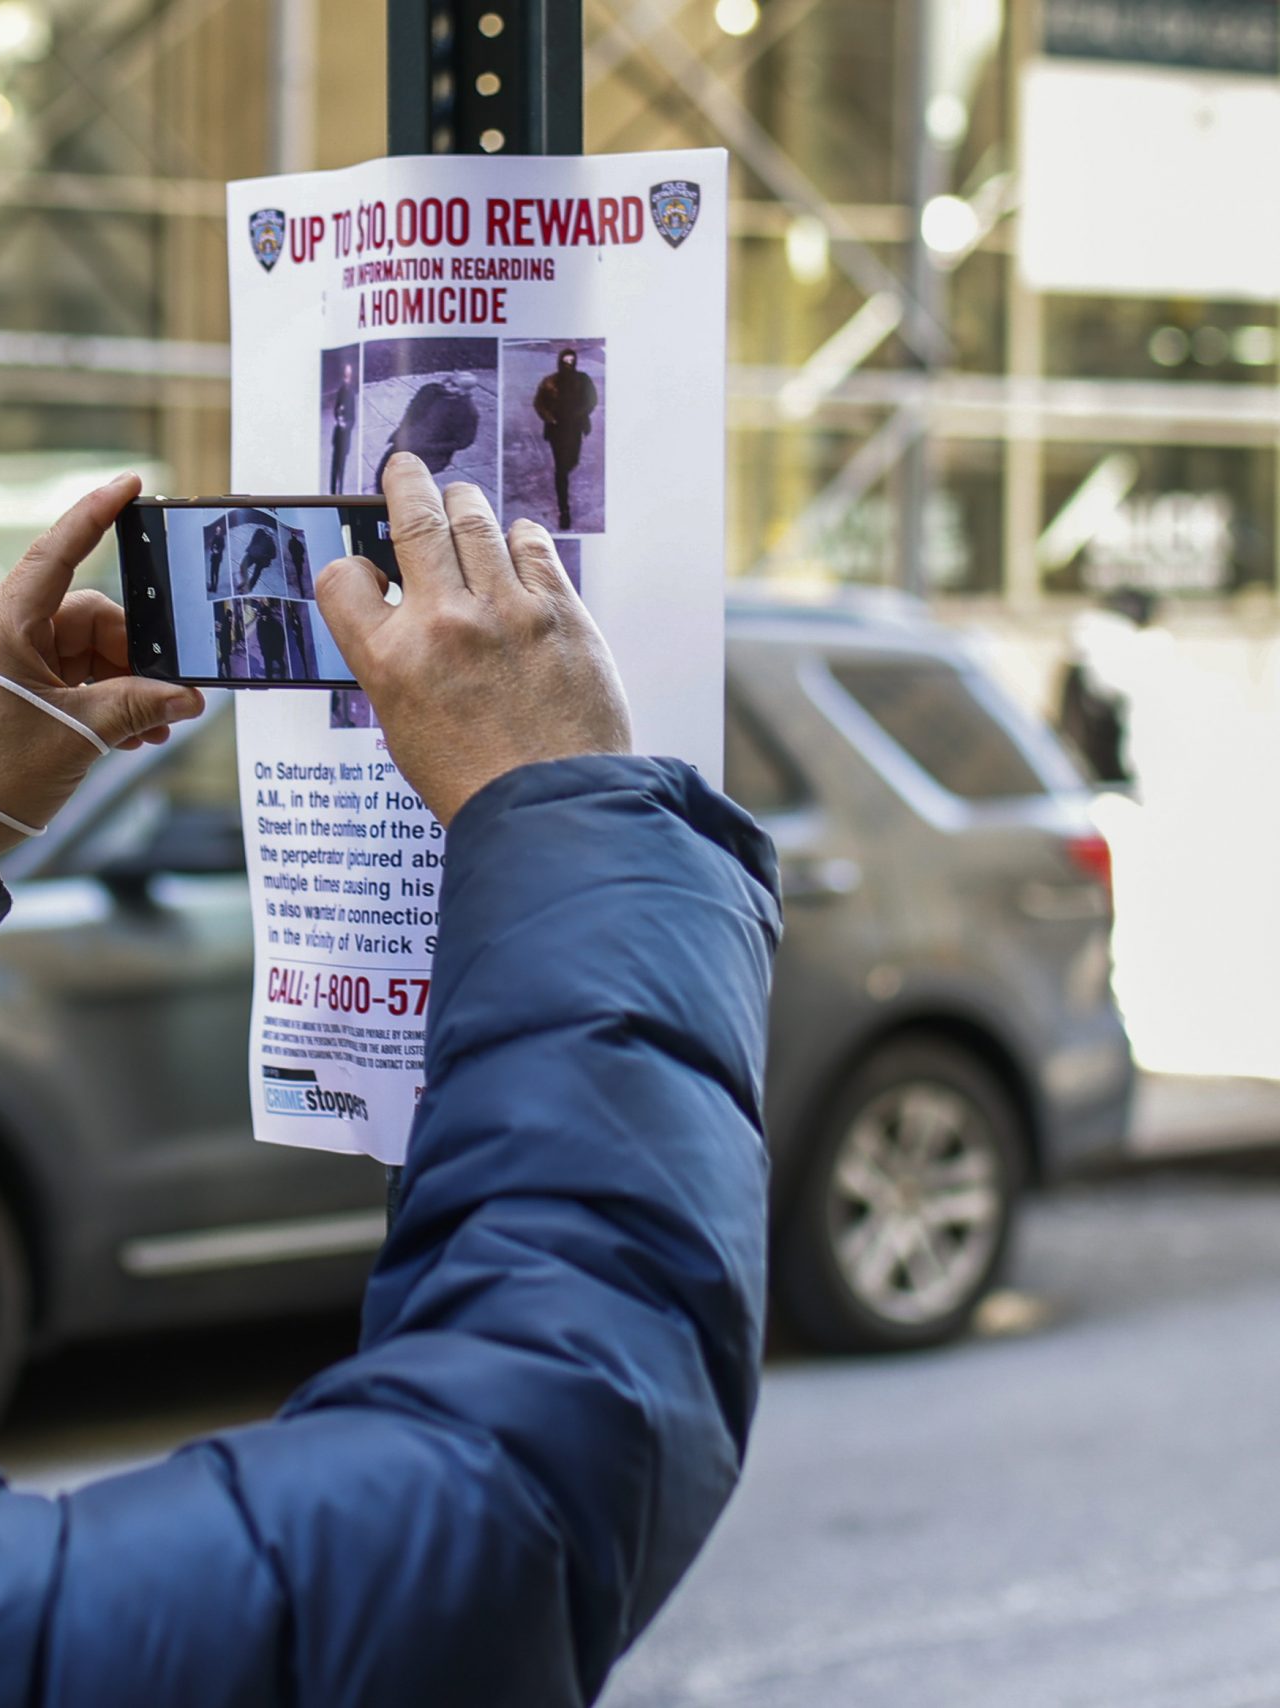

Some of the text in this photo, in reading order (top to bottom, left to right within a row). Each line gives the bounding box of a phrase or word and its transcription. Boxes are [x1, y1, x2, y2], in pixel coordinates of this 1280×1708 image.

[290, 216, 325, 263] UP
[332, 209, 352, 259] TO
[356, 197, 470, 258] $10,000
[486, 196, 644, 247] REWARD
[342, 257, 555, 289] FOR INFORMATION REGARDING
[357, 286, 508, 329] A HOMICIDE
[255, 761, 272, 780] On
[339, 762, 363, 781] March
[290, 789, 303, 808] in
[308, 790, 330, 809] the
[333, 789, 361, 814] vicinity
[364, 791, 379, 810] of
[258, 816, 292, 836] Street
[295, 817, 308, 836] in
[311, 818, 331, 837] the
[332, 819, 367, 839] confines
[370, 820, 386, 839] of
[391, 820, 425, 840] the
[260, 845, 278, 862] the
[282, 847, 344, 868] perpetrator
[264, 873, 435, 901] multiple times causing his
[265, 899, 276, 917] is
[279, 899, 301, 919] also
[303, 904, 336, 921] wanted
[337, 904, 346, 922] in
[268, 925, 279, 943] in
[283, 928, 301, 945] the
[304, 928, 336, 954] vicinity
[338, 932, 350, 950] of
[354, 933, 413, 954] Varick
[267, 966, 311, 1007] CALL:
[392, 1029, 401, 1040] BY
[380, 1044, 403, 1056] ABOVE
[375, 1058, 404, 1070] CONTACT
[266, 1084, 368, 1121] CRIME stoppers
